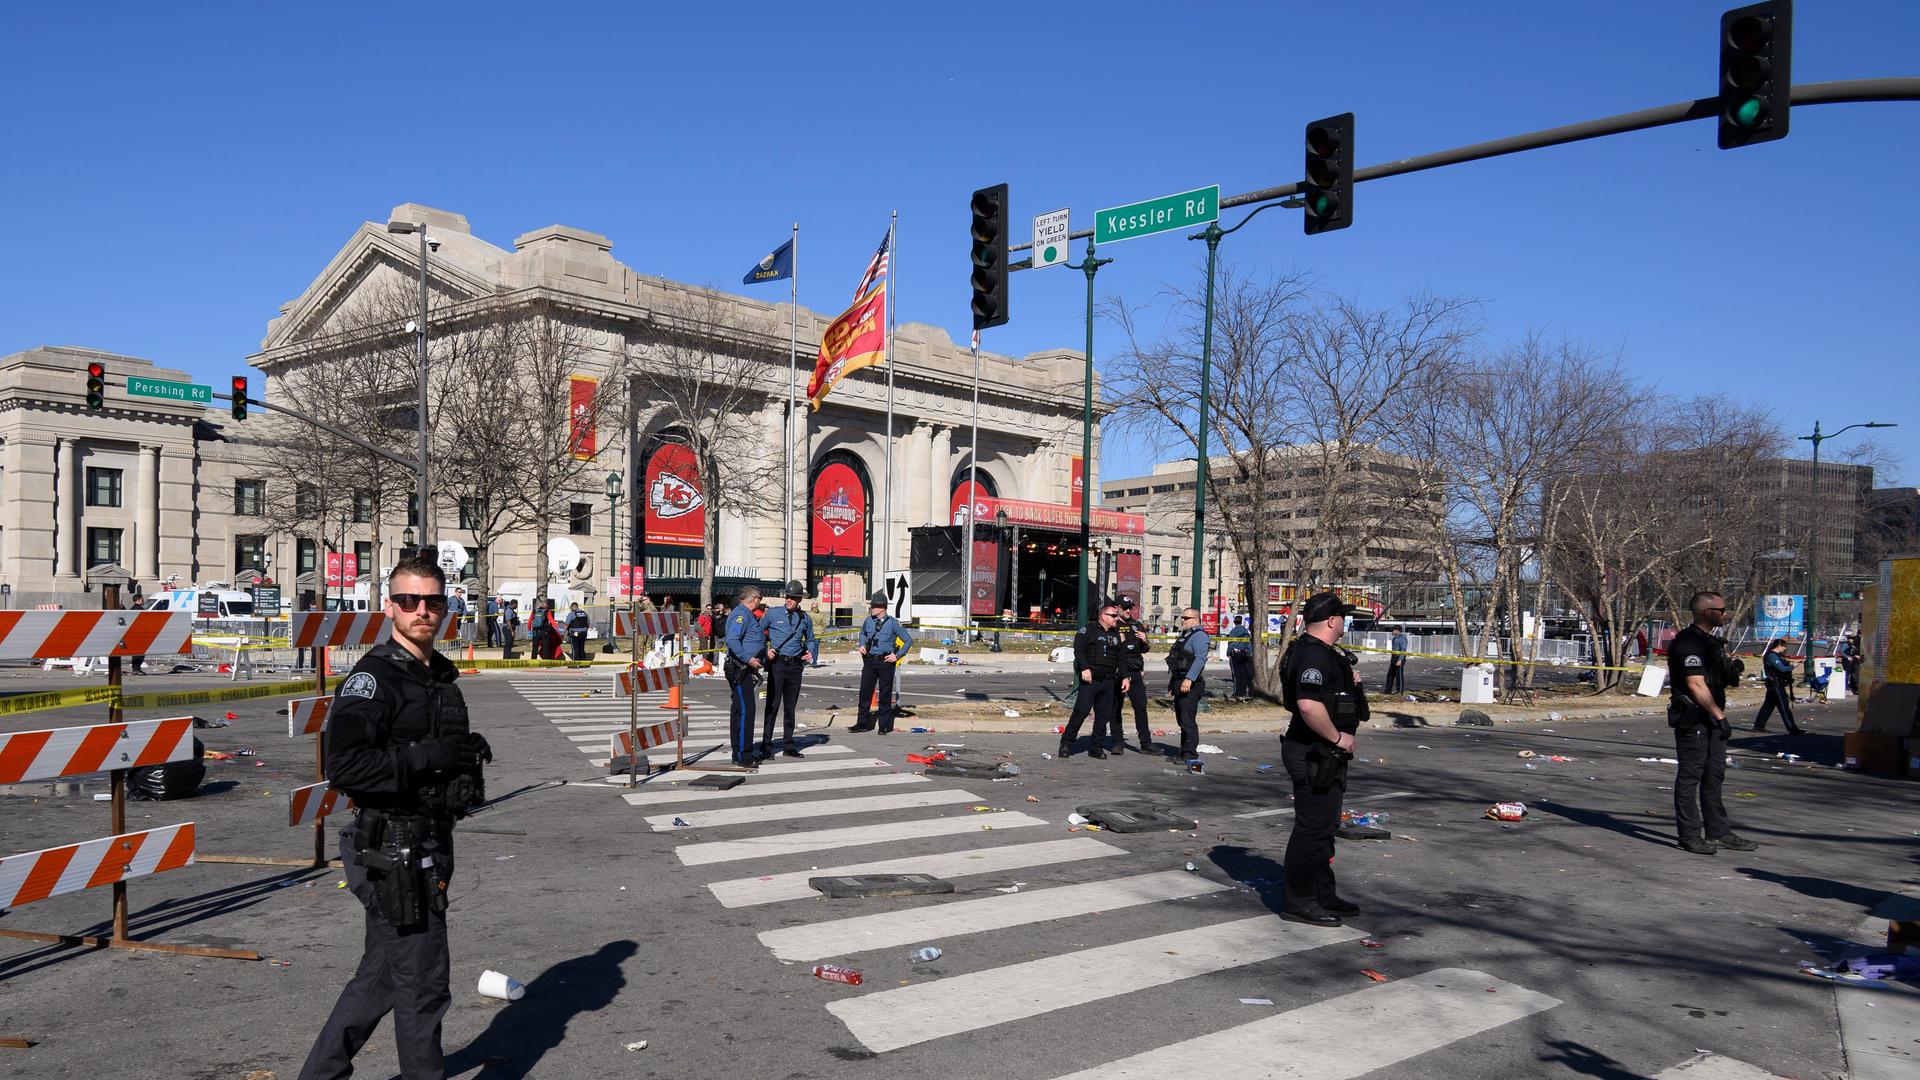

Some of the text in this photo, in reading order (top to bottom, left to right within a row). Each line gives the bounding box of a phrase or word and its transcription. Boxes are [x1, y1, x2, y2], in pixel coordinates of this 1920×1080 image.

[1036, 213, 1068, 227] LEFT TURN
[1108, 197, 1205, 234] Kessler Rd
[1038, 223, 1065, 237] YIELD
[1036, 234, 1067, 247] ON GREEN
[135, 382, 205, 399] Pershing Rd
[663, 483, 692, 509] KC
[822, 505, 856, 523] CHAMPIONS
[714, 565, 745, 578] KANSAS
